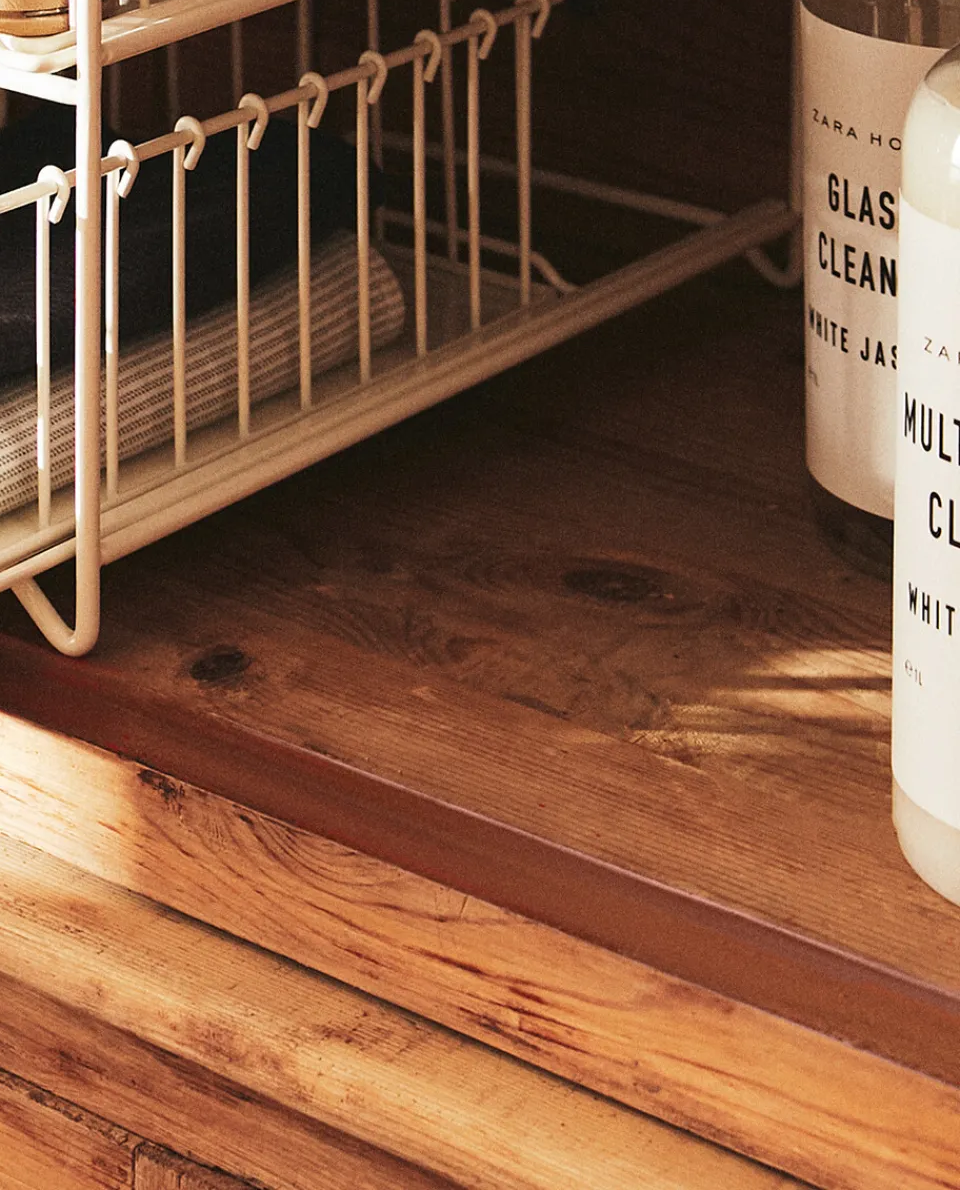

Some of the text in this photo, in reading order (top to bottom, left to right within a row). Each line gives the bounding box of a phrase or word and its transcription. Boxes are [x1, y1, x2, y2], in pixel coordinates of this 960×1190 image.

[813, 109, 858, 139] ZARA
[828, 173, 895, 230] GLAS
[819, 231, 897, 297] CLEAN
[809, 304, 848, 353] WHITE
[924, 336, 960, 364] ZA
[929, 491, 960, 549] CL
[908, 582, 956, 636] WHIT
